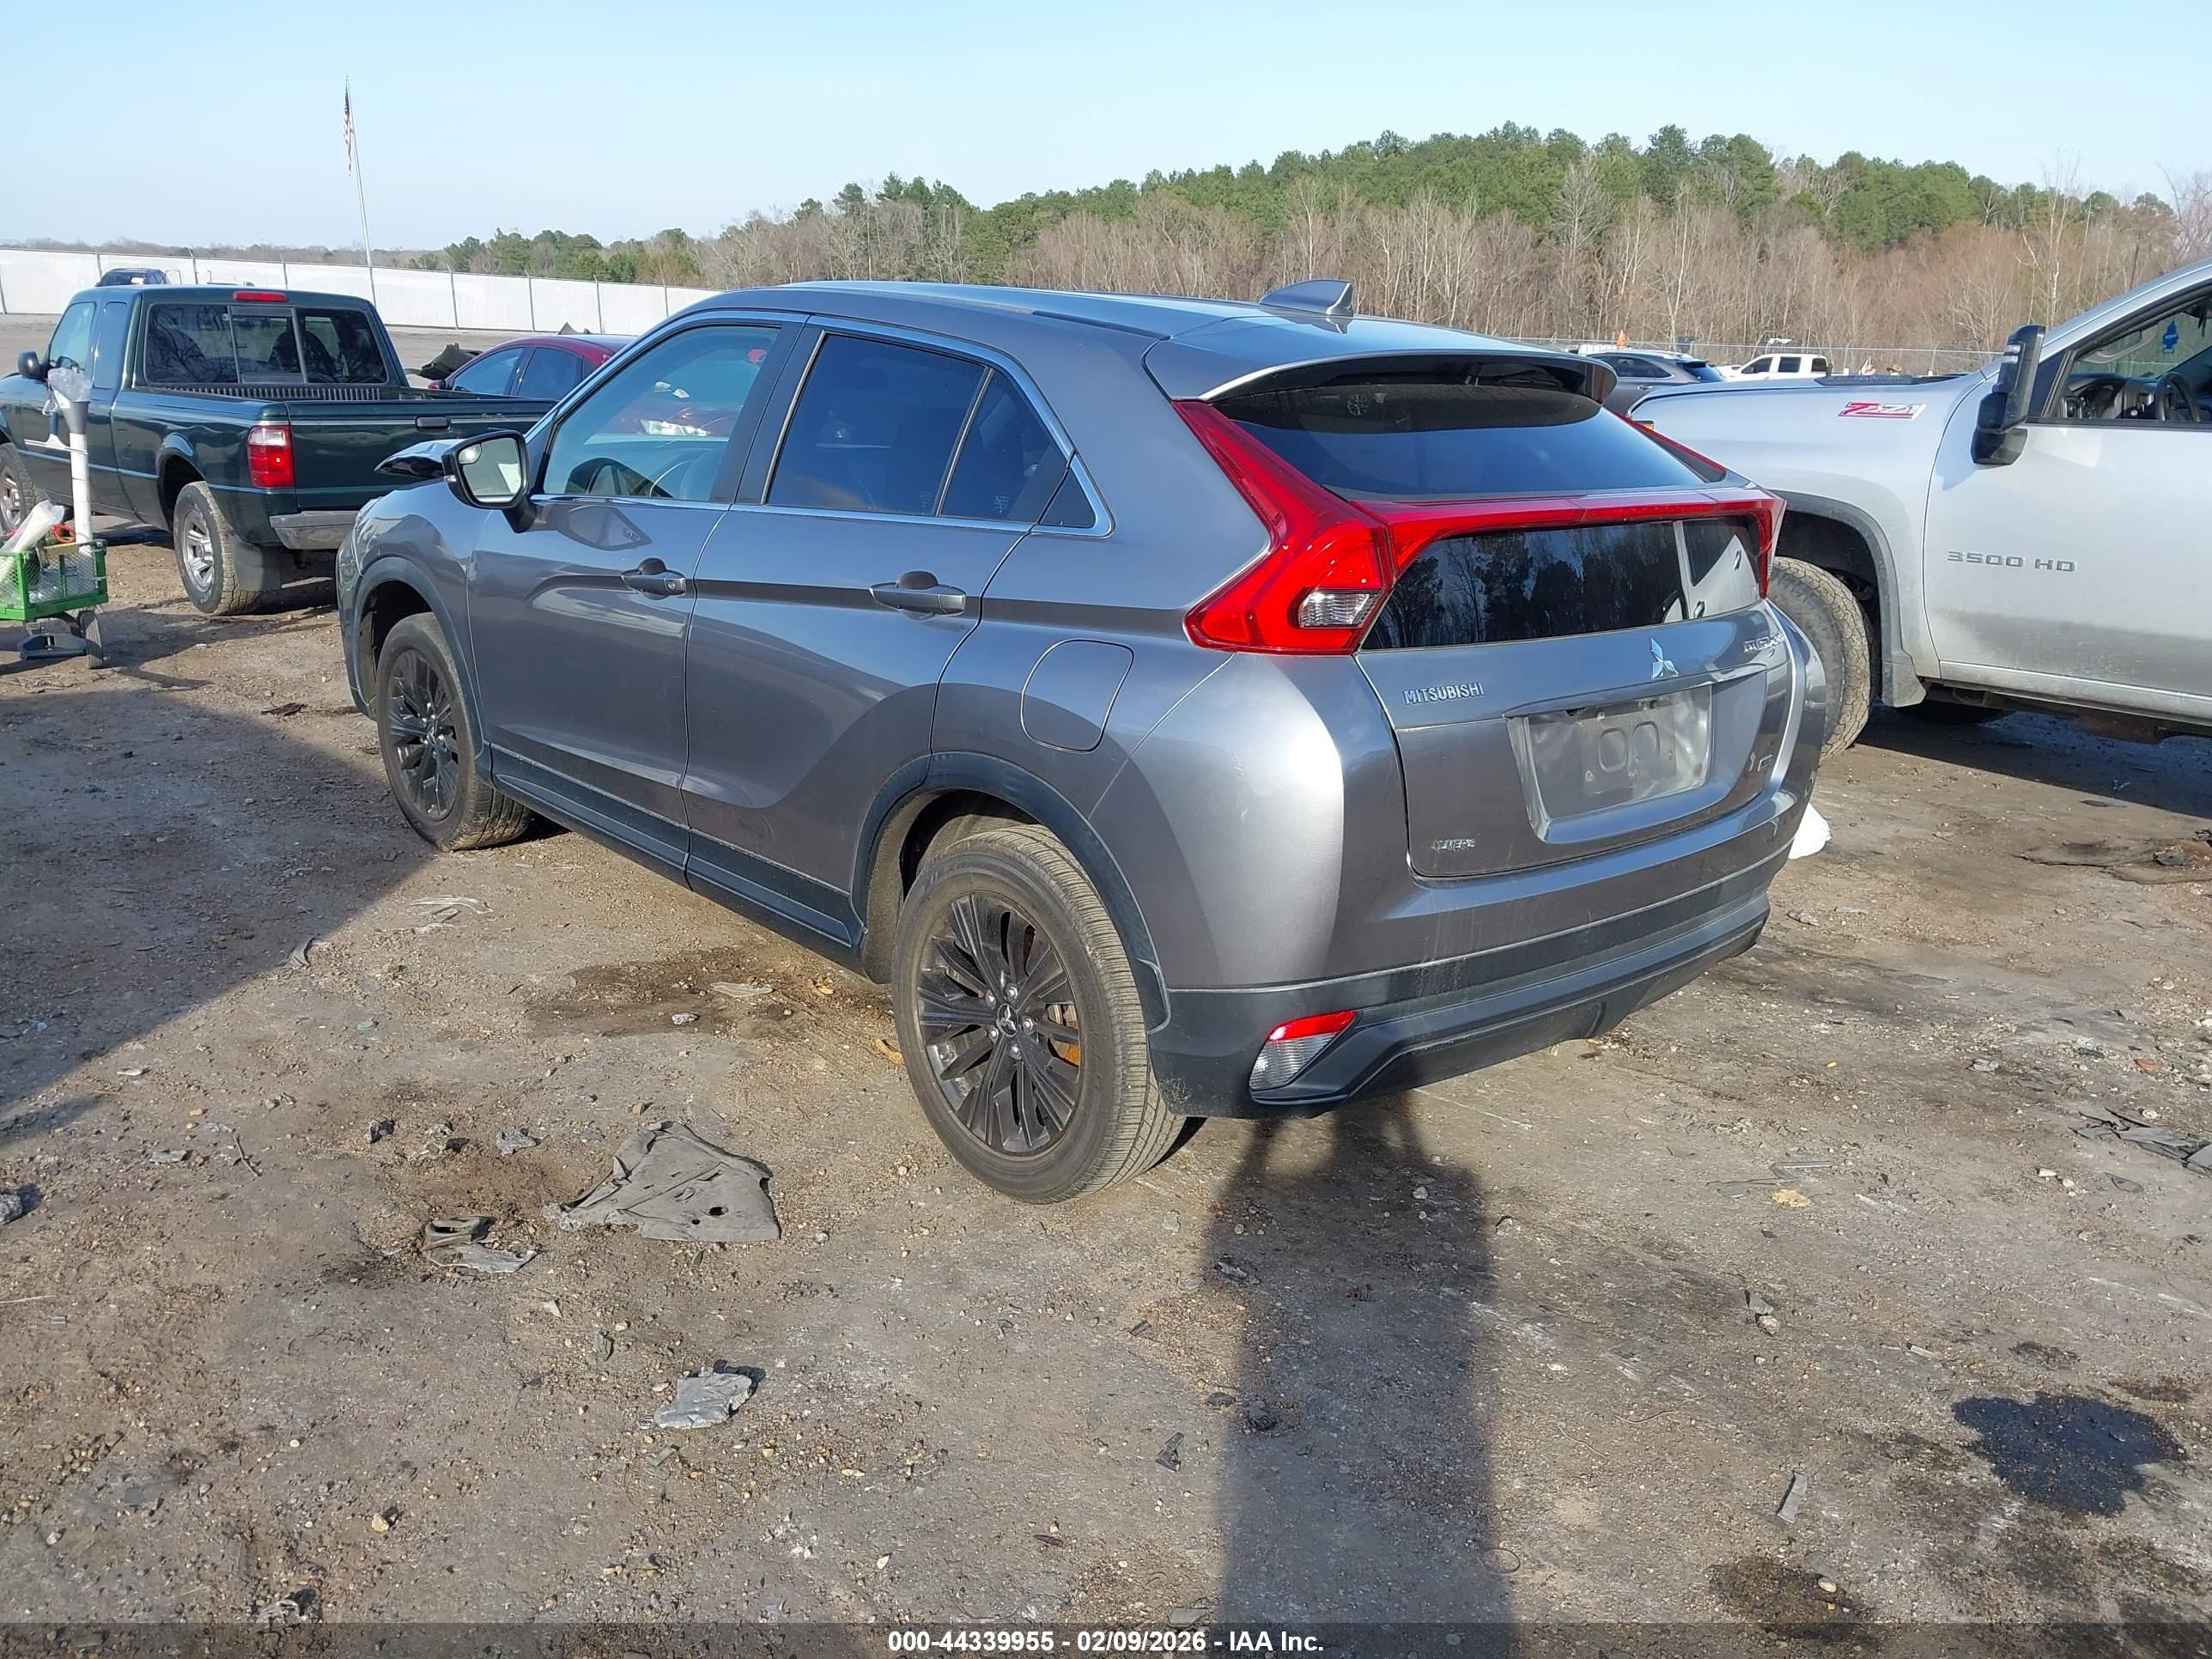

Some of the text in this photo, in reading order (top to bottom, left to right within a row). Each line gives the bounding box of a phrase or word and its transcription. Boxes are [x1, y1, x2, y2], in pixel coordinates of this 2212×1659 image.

[1947, 550, 2076, 573] 3500 HD
[1402, 682, 1484, 705] MITSUBISHI
